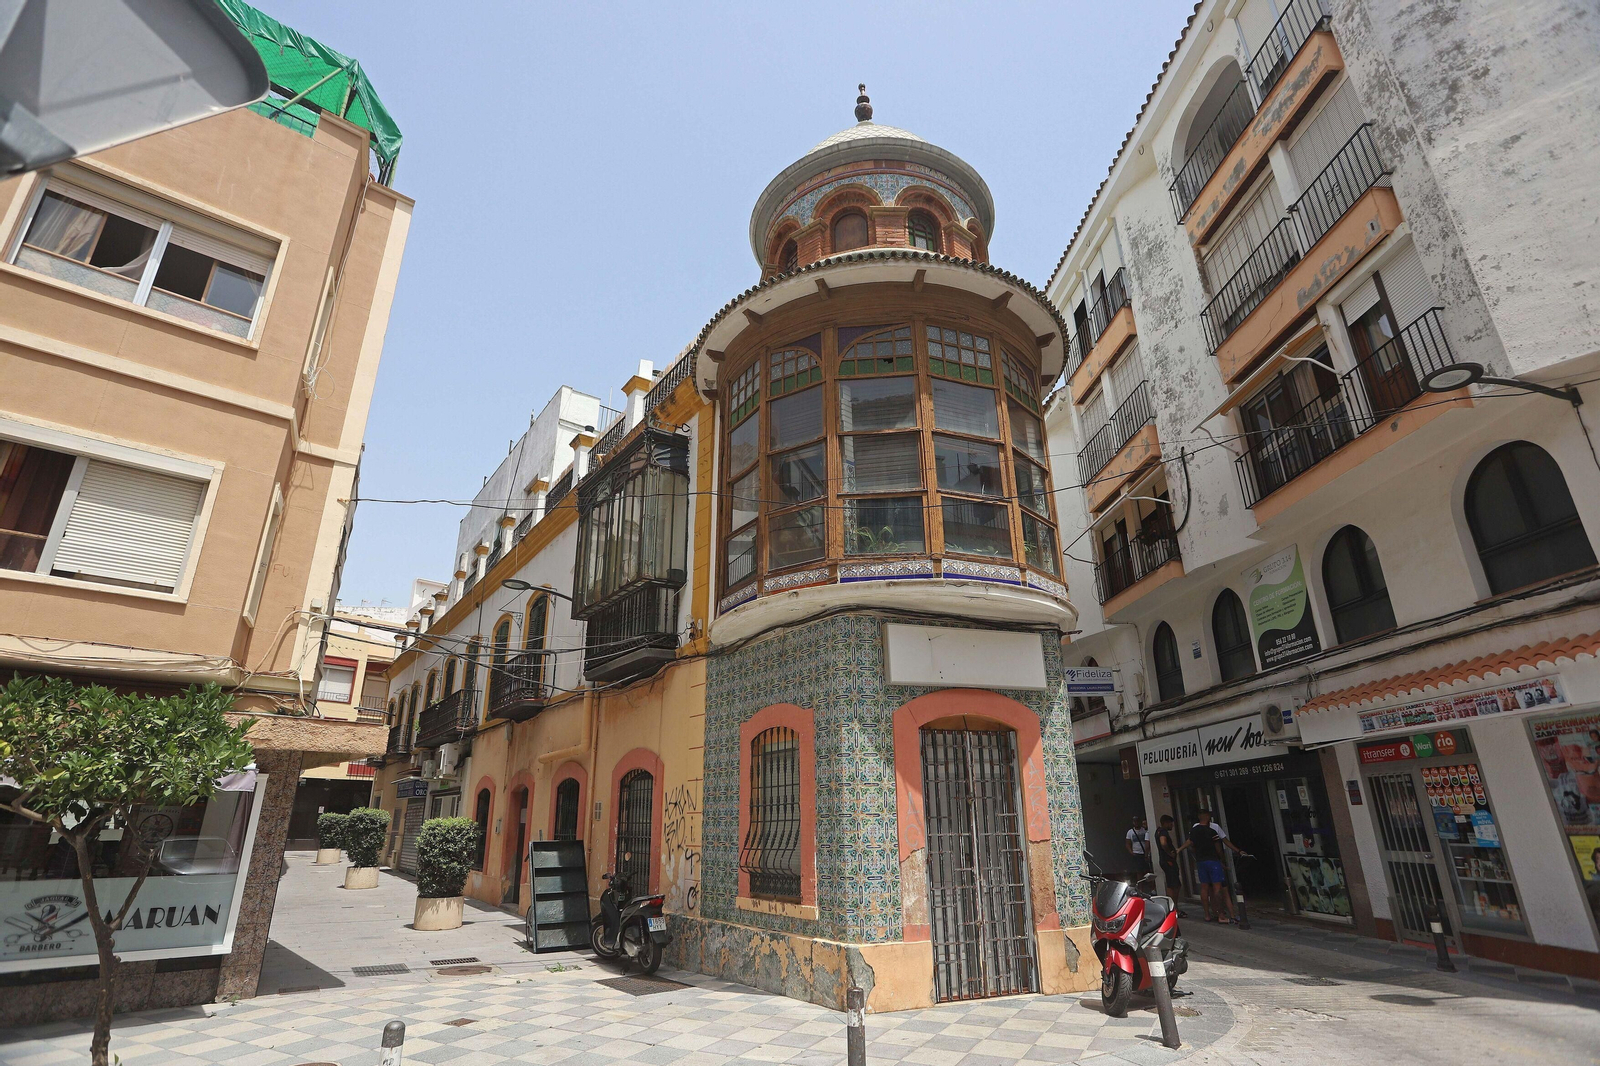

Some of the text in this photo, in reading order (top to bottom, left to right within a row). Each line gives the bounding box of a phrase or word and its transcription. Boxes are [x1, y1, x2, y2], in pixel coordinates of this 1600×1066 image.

[1076, 669, 1112, 678] Fideliza
[1205, 722, 1266, 755] new loo
[1535, 727, 1573, 738] SABORES
[1415, 741, 1432, 751] Wari
[1436, 733, 1454, 748] ria
[1143, 742, 1197, 765] PELUQUERÍA
[1363, 747, 1396, 759] itransfer
[1229, 768, 1238, 777] 301
[1251, 765, 1262, 774] 631
[1262, 763, 1273, 772] 226
[1273, 762, 1285, 771] 824
[19, 943, 62, 952] BARBERO
